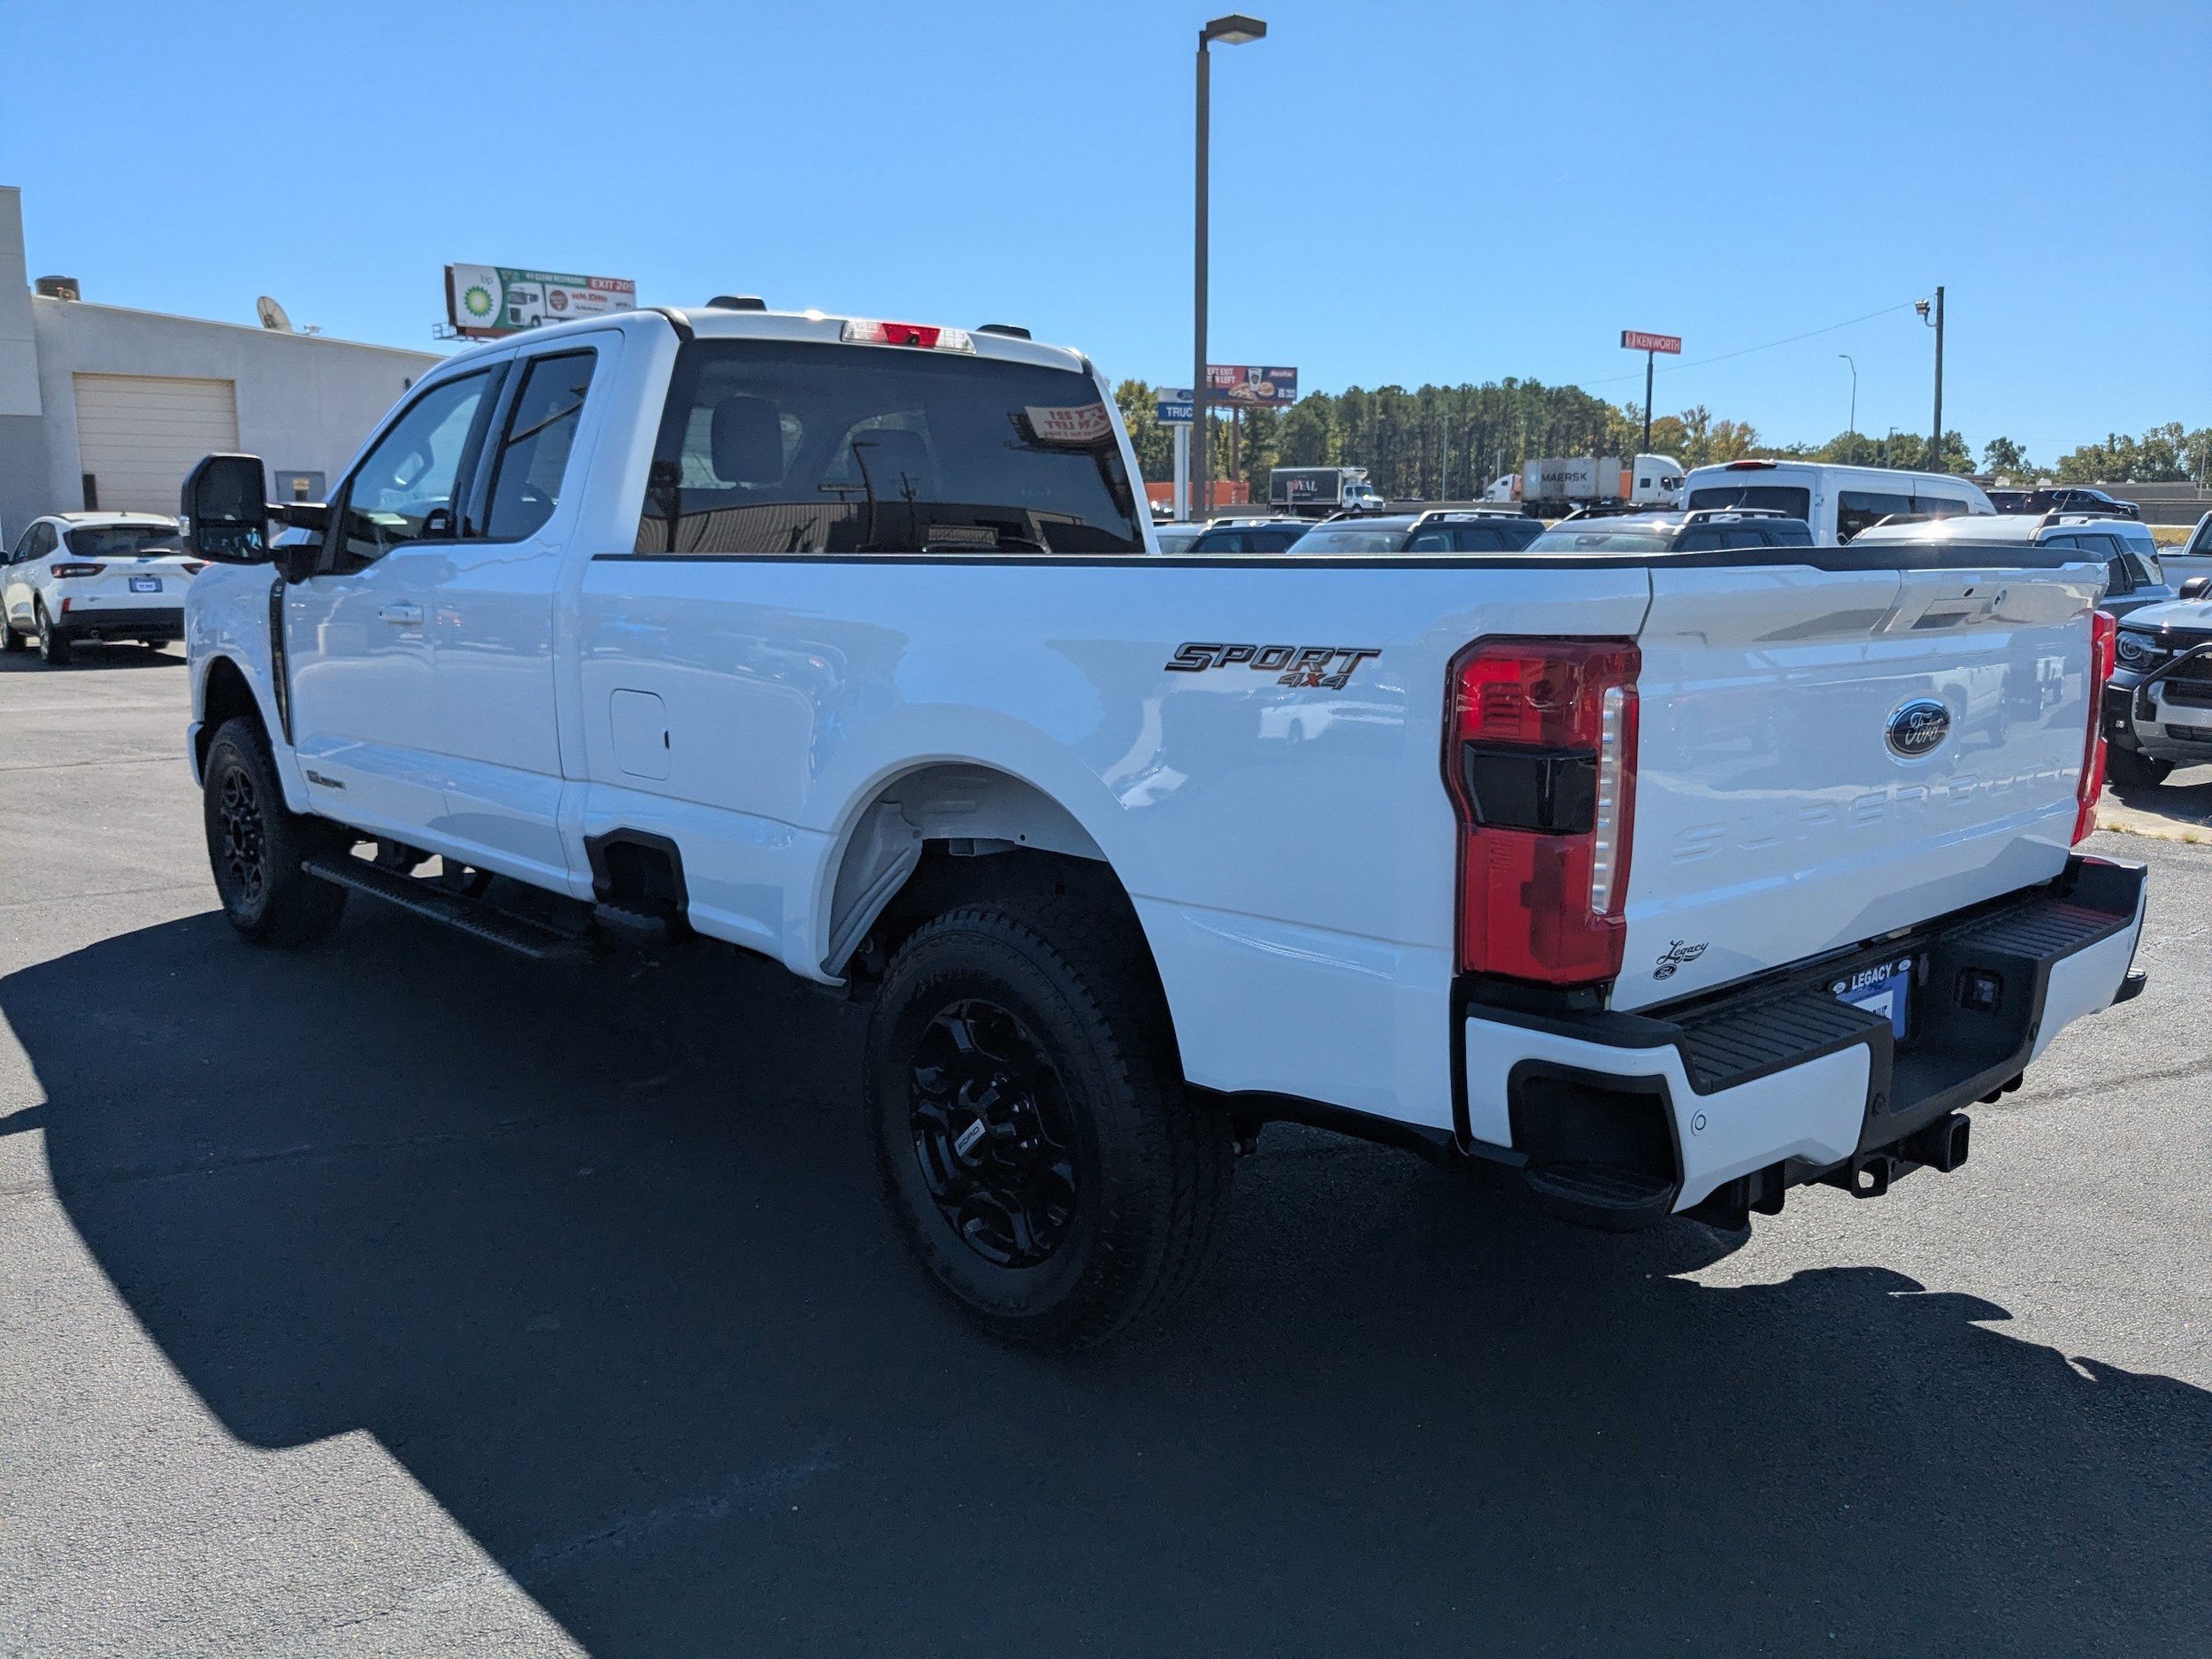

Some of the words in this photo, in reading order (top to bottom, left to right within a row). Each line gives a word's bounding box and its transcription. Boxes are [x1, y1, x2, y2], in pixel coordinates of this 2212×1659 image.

[591, 280, 614, 290] EXIT
[1636, 334, 1679, 351] KENWORTH
[1166, 407, 1194, 418] TRUC
[1541, 472, 1587, 482] MAERSK
[1164, 641, 1383, 674] SPORT
[1656, 940, 1709, 965] Legacy
[1852, 963, 1893, 990] LEGACY
[958, 1126, 979, 1149] FORD
